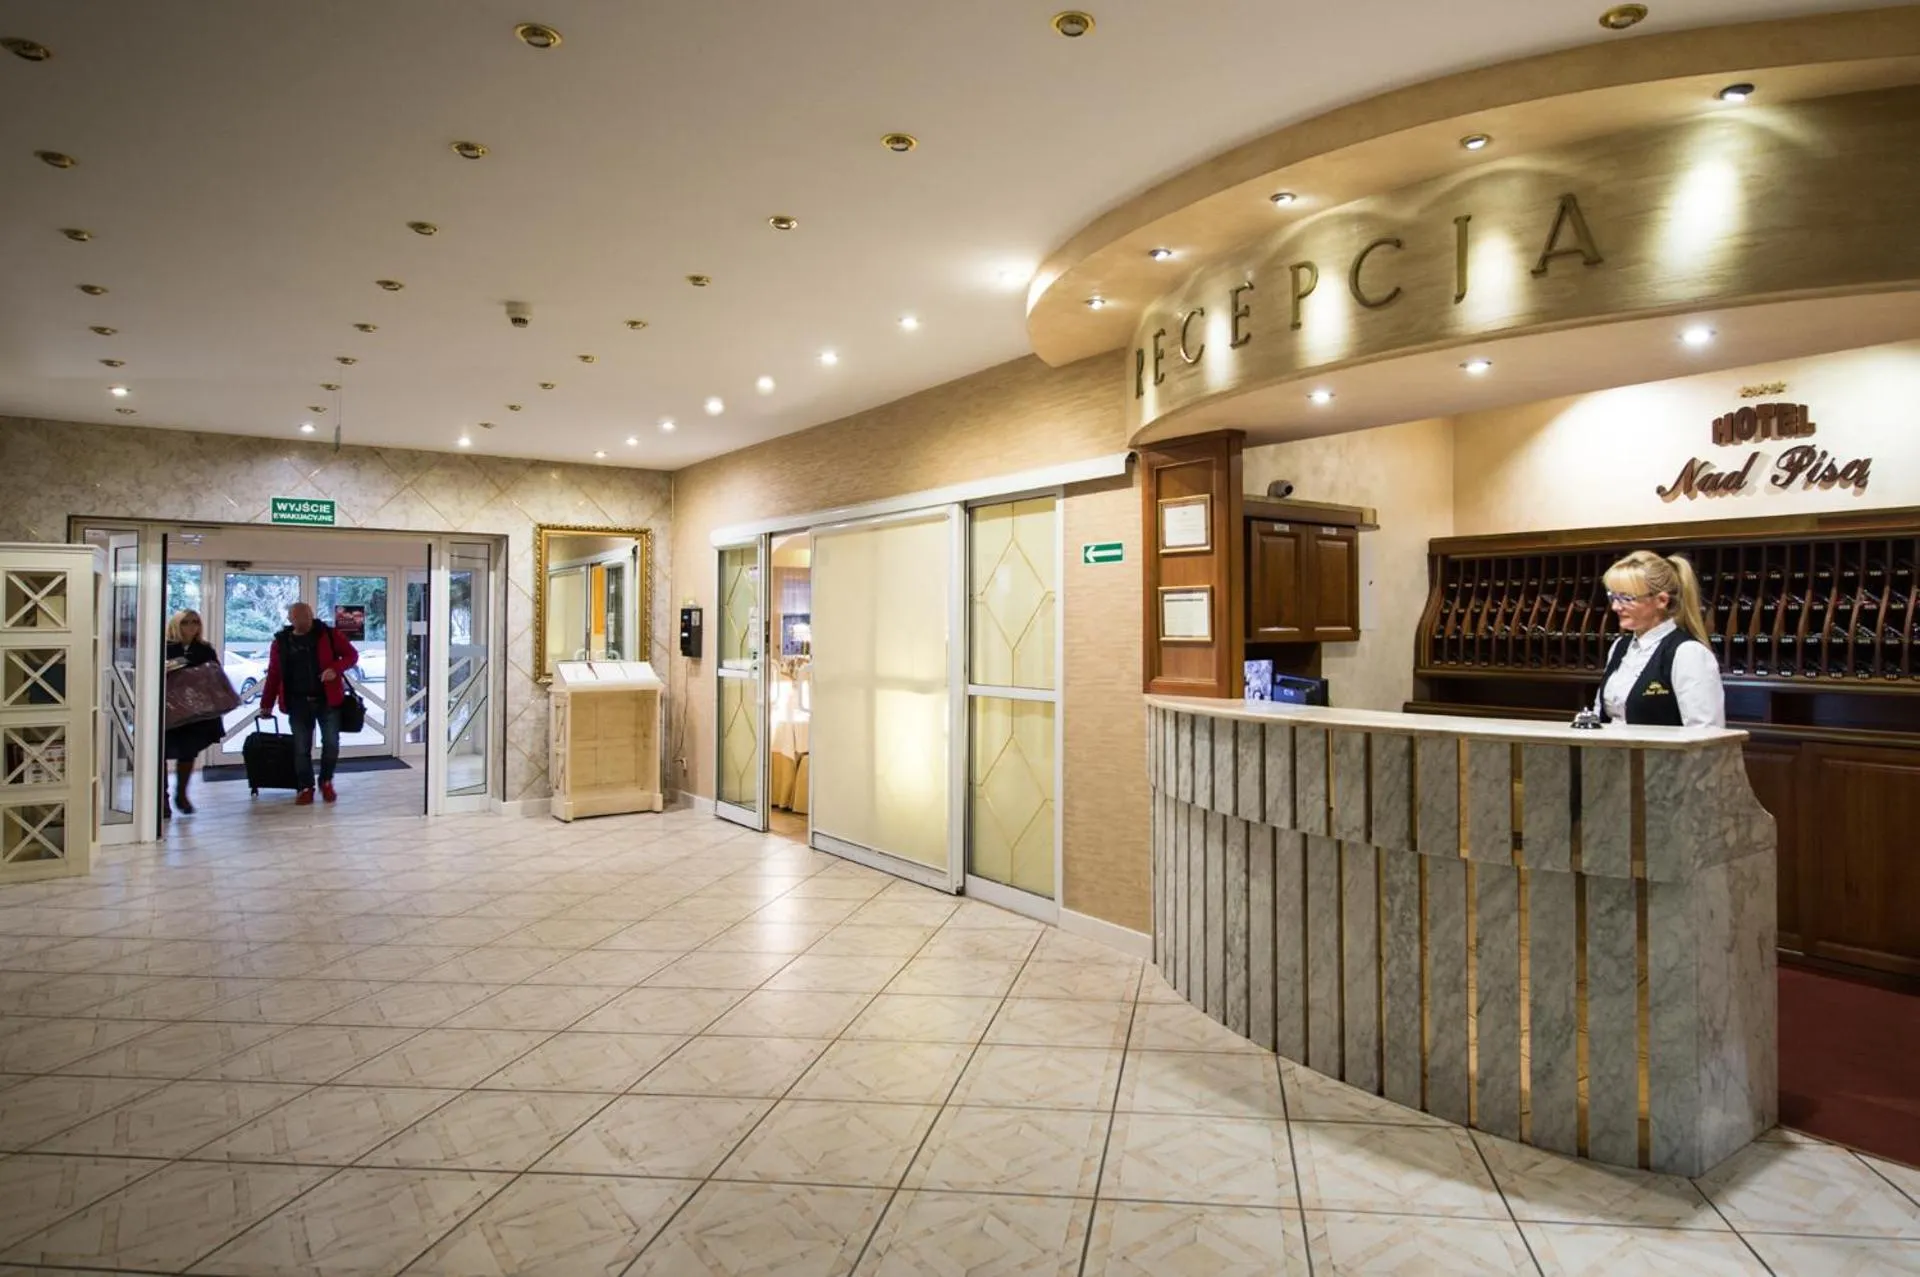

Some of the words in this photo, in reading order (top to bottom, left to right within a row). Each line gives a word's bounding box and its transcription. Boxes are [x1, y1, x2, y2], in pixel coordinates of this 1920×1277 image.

[1135, 192, 1605, 400] RECEPCJA
[1711, 402, 1817, 445] HOTEL
[1655, 451, 1761, 497] Nad
[273, 512, 334, 522] EWAKUACYJNE
[276, 501, 331, 514] WYJŚCIE
